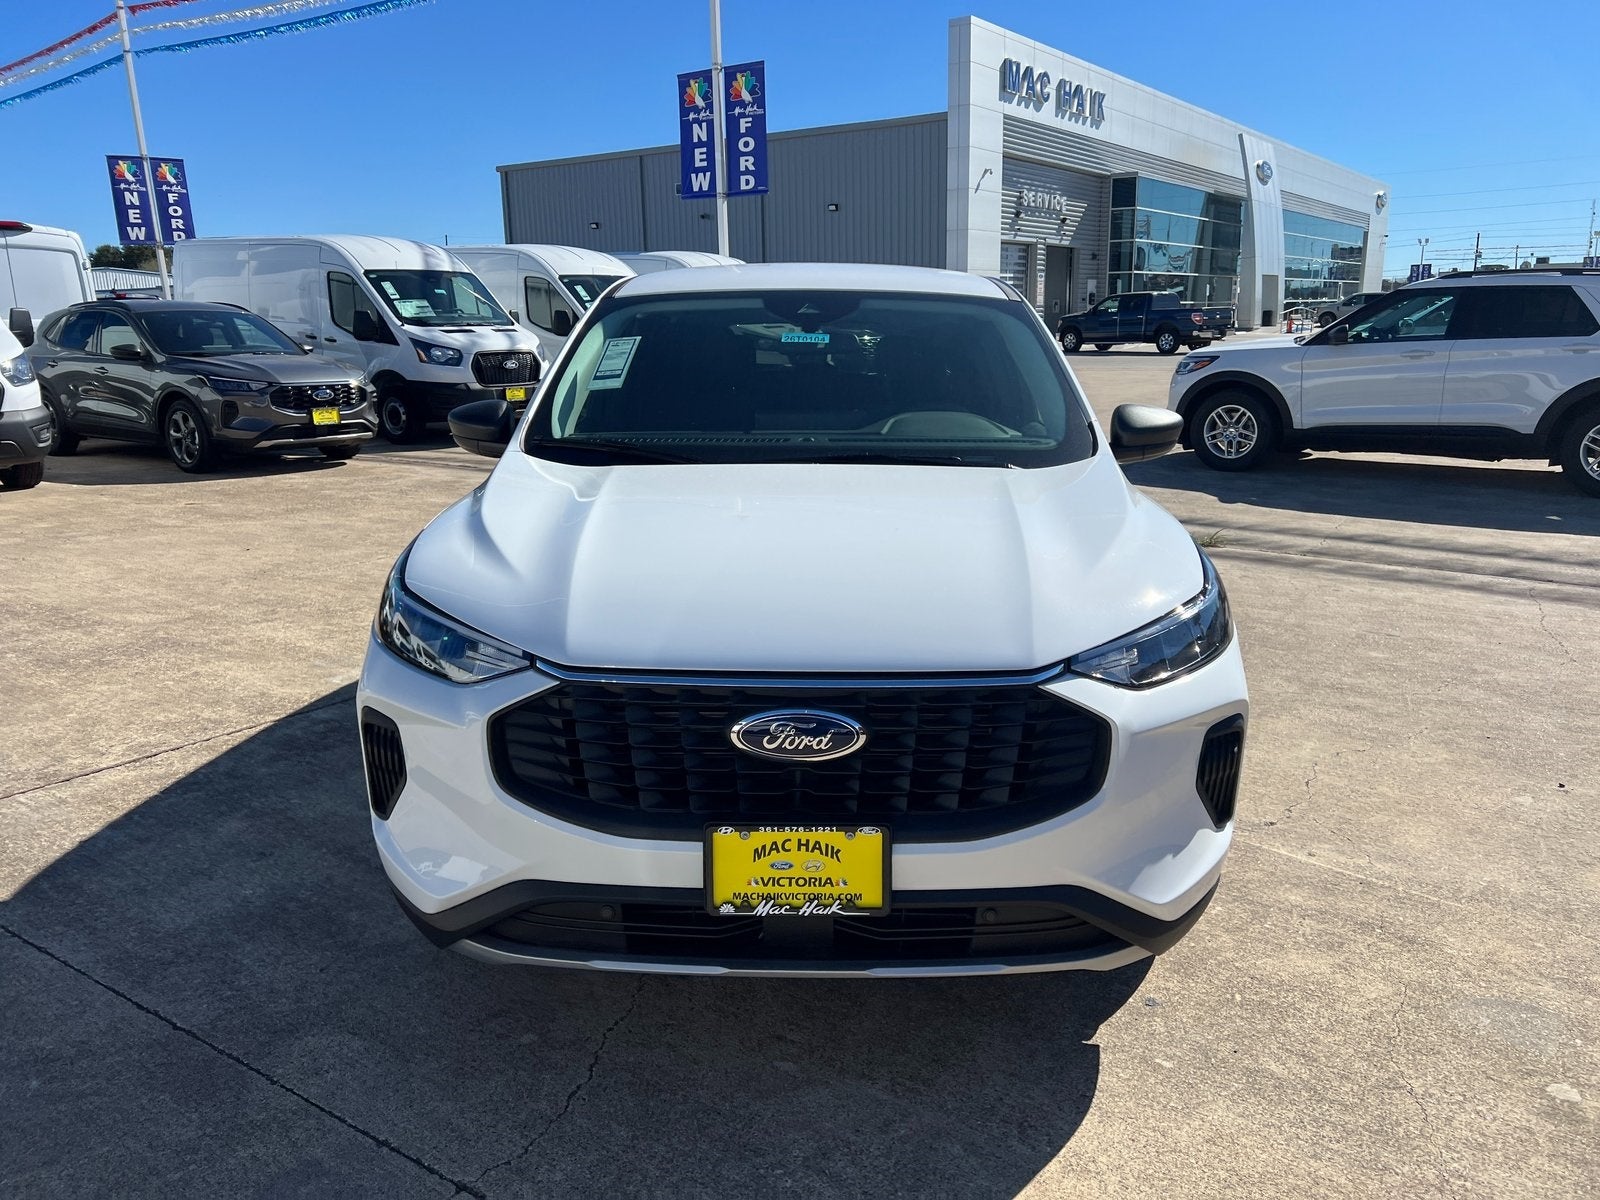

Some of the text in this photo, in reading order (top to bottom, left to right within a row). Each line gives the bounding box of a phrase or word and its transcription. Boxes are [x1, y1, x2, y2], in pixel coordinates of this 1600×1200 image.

[1000, 58, 1106, 121] MAC HAIK
[691, 123, 710, 191] NEW
[738, 118, 755, 190] FORD
[1022, 188, 1067, 211] SERVICE
[124, 192, 145, 240] NEW
[167, 193, 186, 242] FORD
[762, 721, 833, 750] Ford
[753, 838, 842, 863] MAC HAIK
[732, 892, 863, 901] MACHAIKVICTORIA.COM
[760, 877, 835, 888] VICTORIA
[752, 900, 845, 917] Mac Haik
